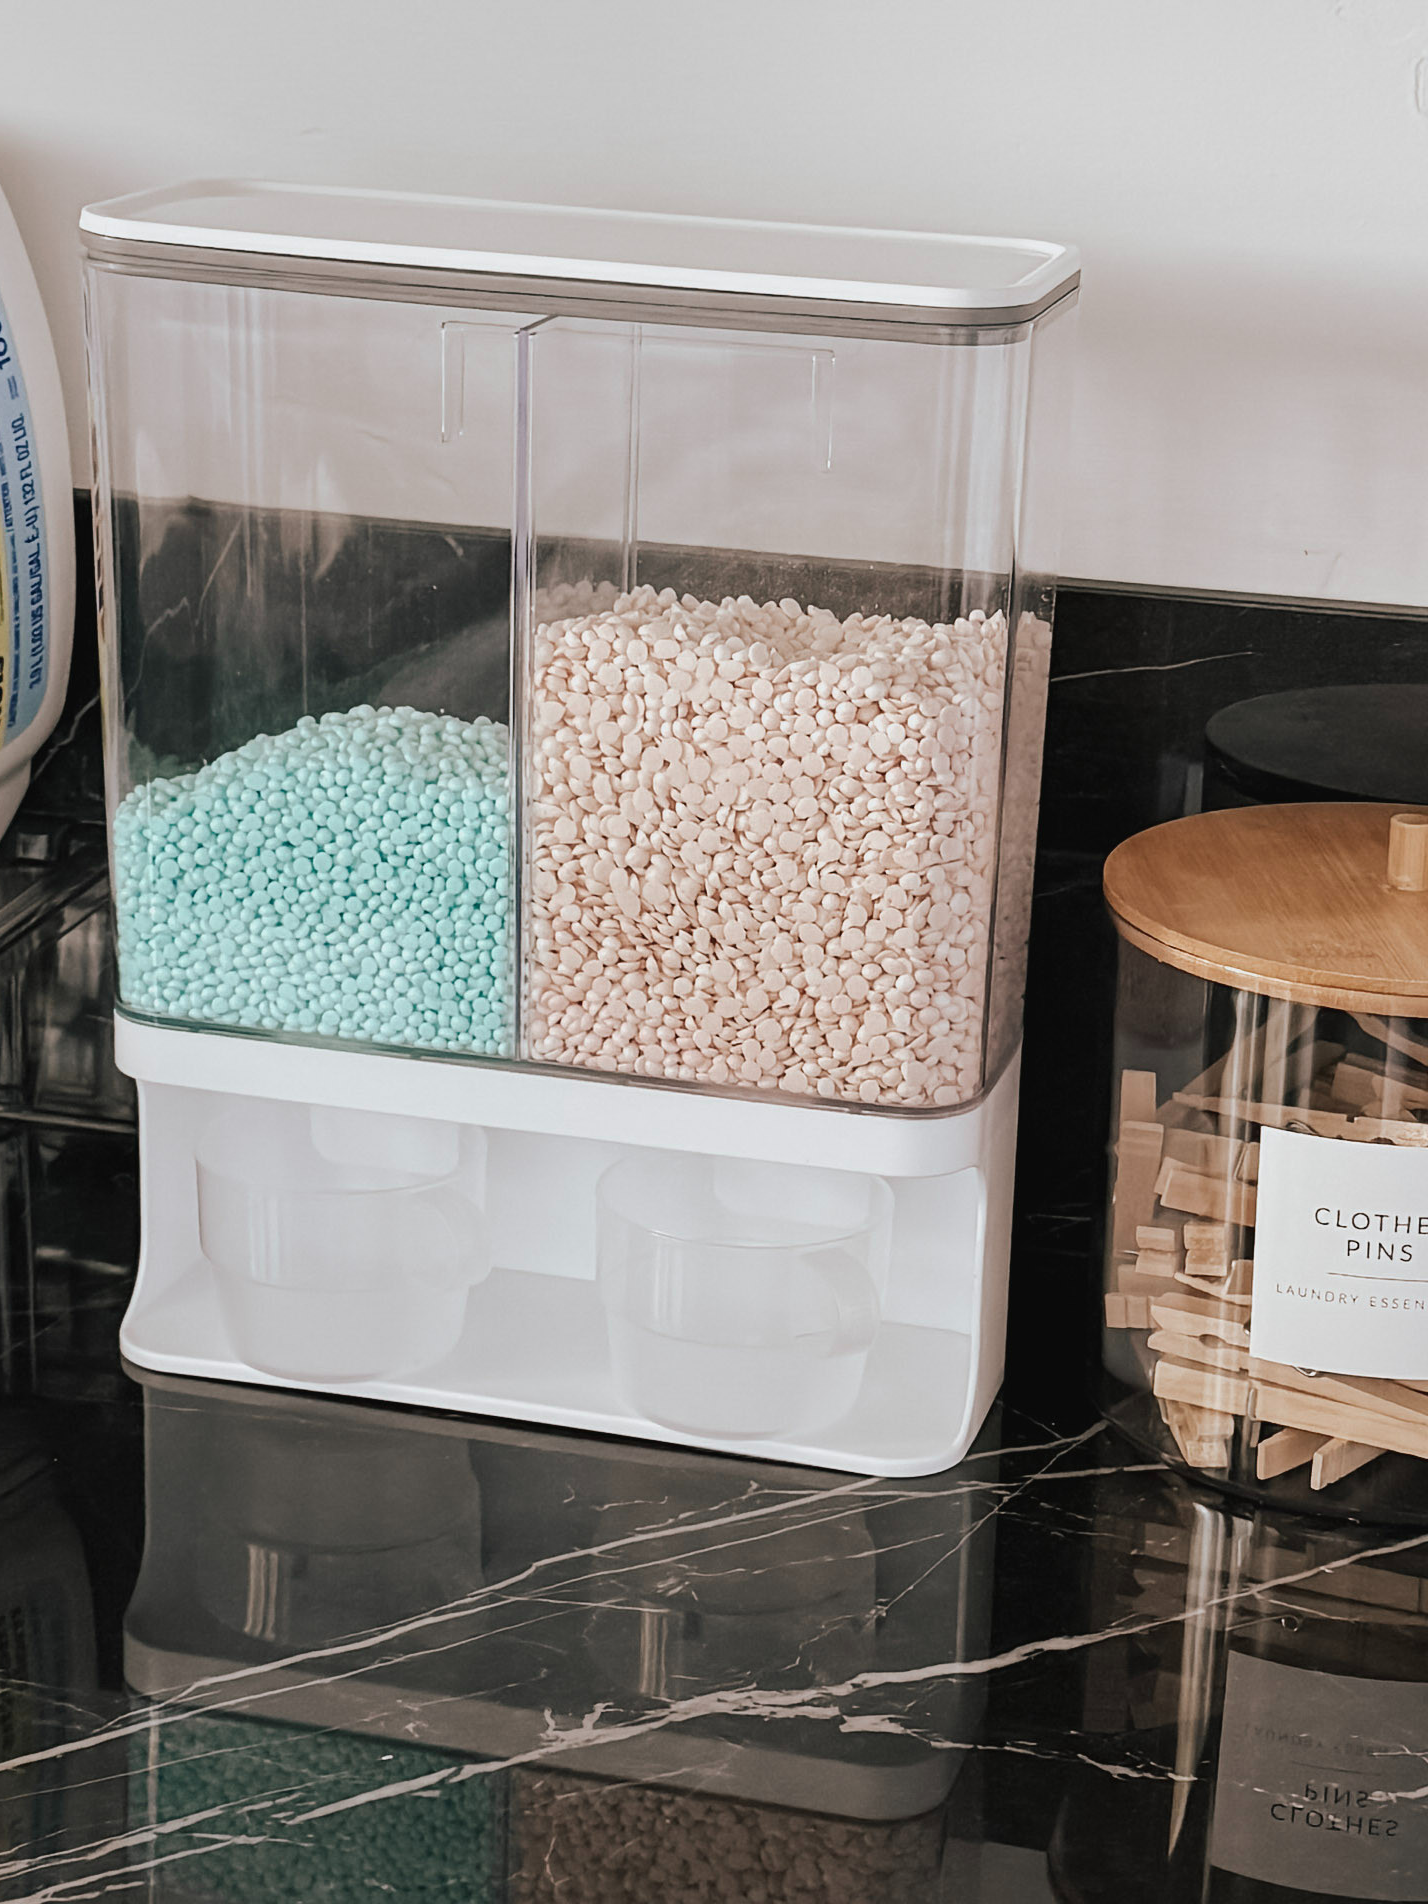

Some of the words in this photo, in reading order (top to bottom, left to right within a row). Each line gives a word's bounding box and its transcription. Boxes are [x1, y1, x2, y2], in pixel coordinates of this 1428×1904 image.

[15, 441, 30, 461] OZ
[19, 461, 33, 481] FL
[21, 480, 37, 506] 132
[1347, 1238, 1414, 1263] PINS
[1275, 1282, 1360, 1305] LAUNDRY
